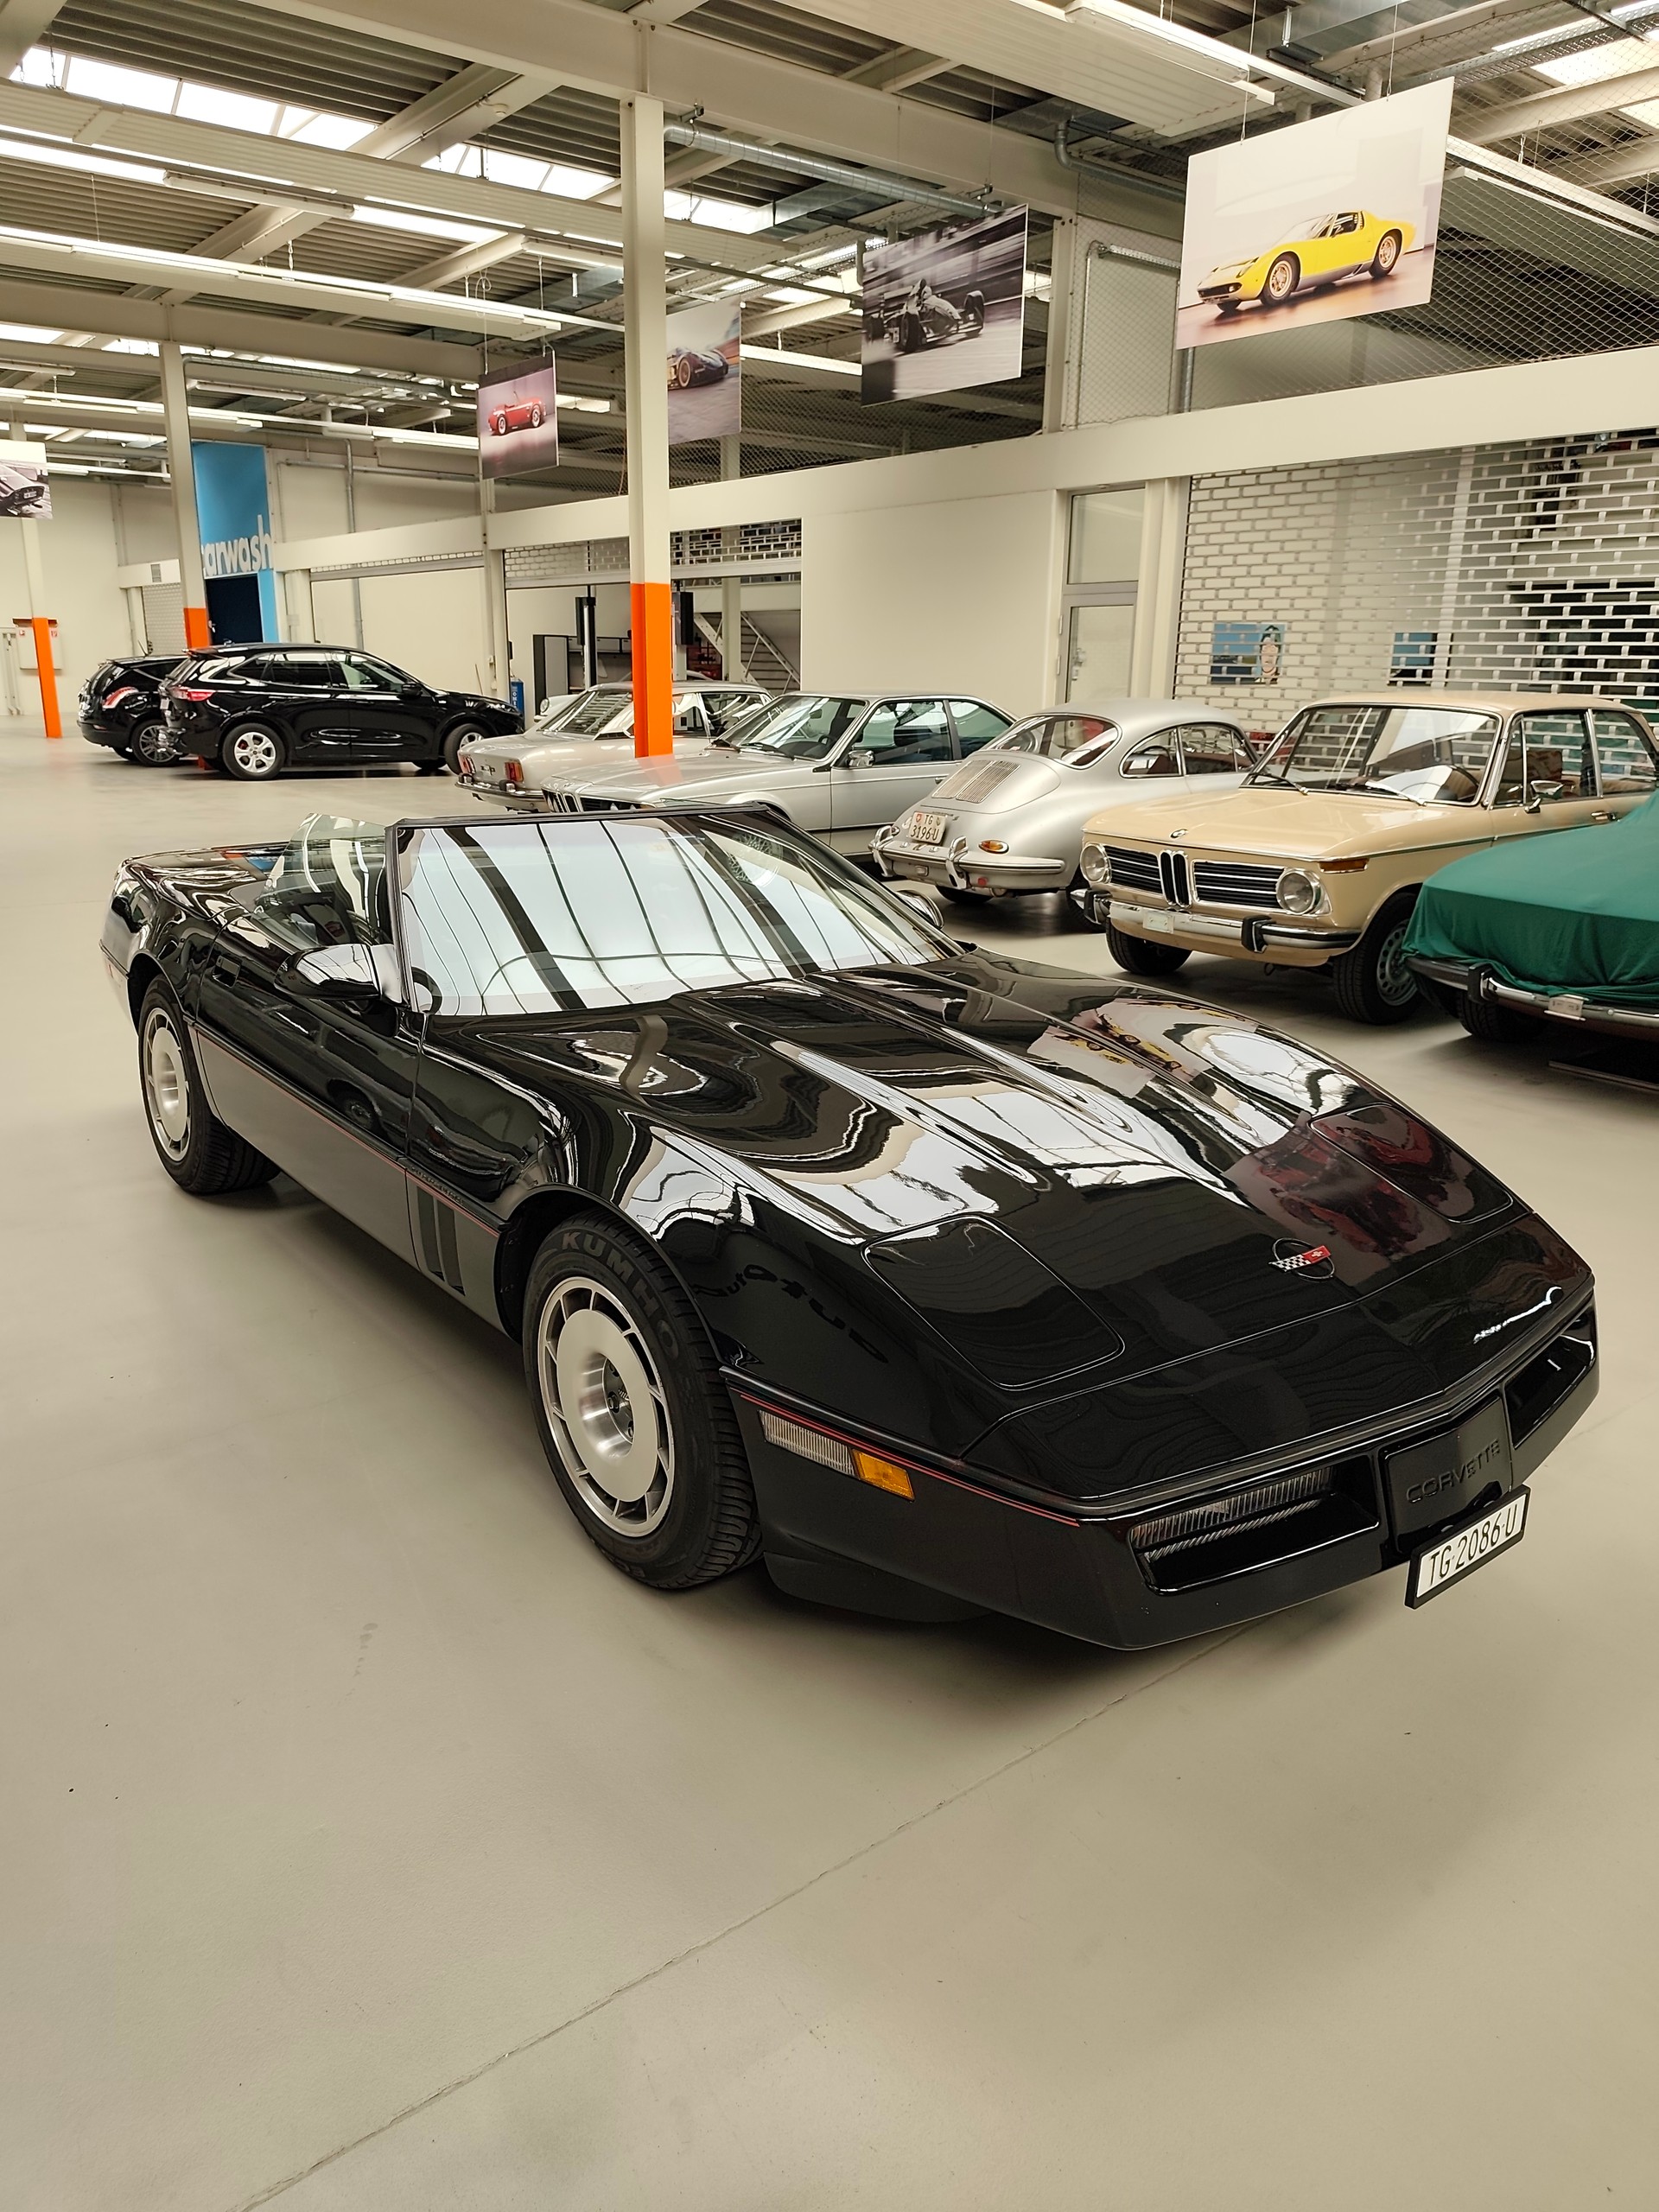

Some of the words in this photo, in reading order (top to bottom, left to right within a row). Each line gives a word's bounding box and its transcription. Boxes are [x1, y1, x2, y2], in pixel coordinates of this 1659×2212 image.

[201, 514, 273, 577] arwash
[925, 814, 934, 825] TG
[1406, 1438, 1501, 1503] CORVETTE
